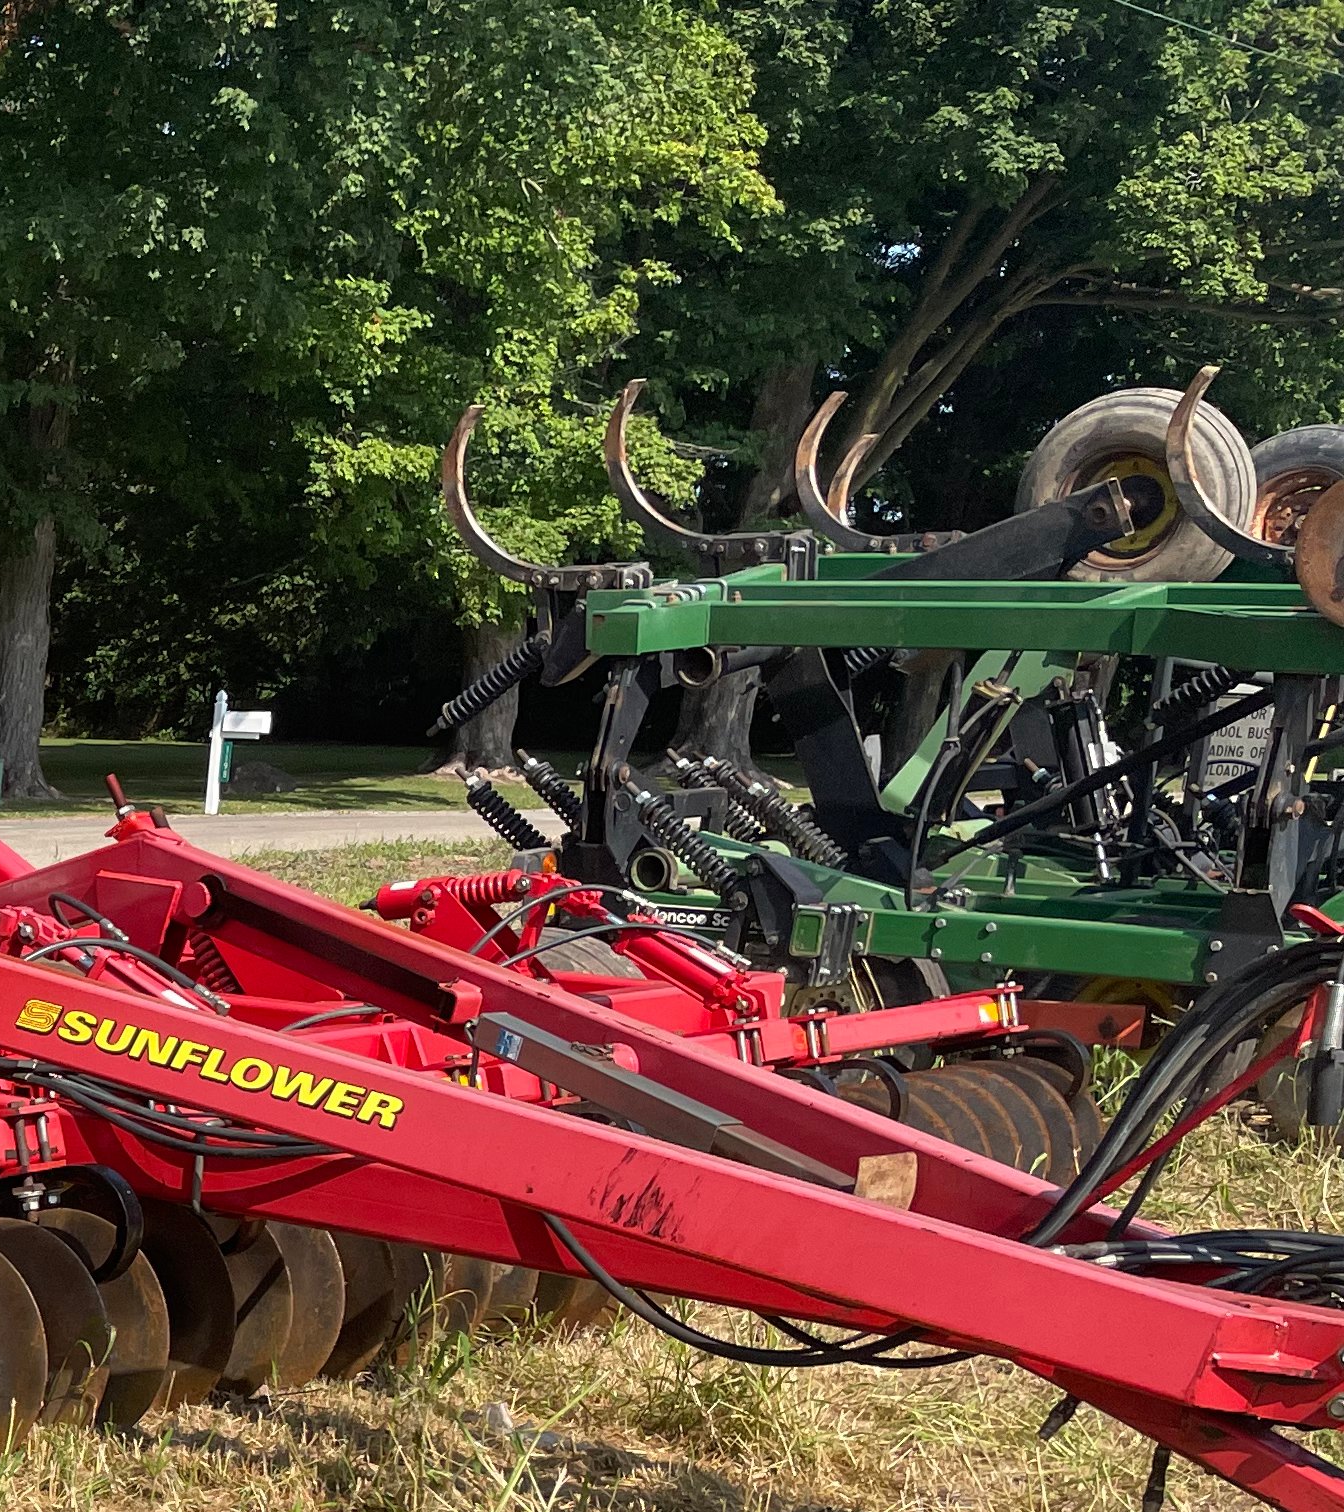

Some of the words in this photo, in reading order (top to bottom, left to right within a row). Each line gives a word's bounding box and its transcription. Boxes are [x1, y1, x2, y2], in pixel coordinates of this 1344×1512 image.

[1244, 709, 1267, 720] OR
[1247, 727, 1271, 739] BUS
[1208, 745, 1244, 757] ADING
[56, 1010, 404, 1131] SUNFLOWER
